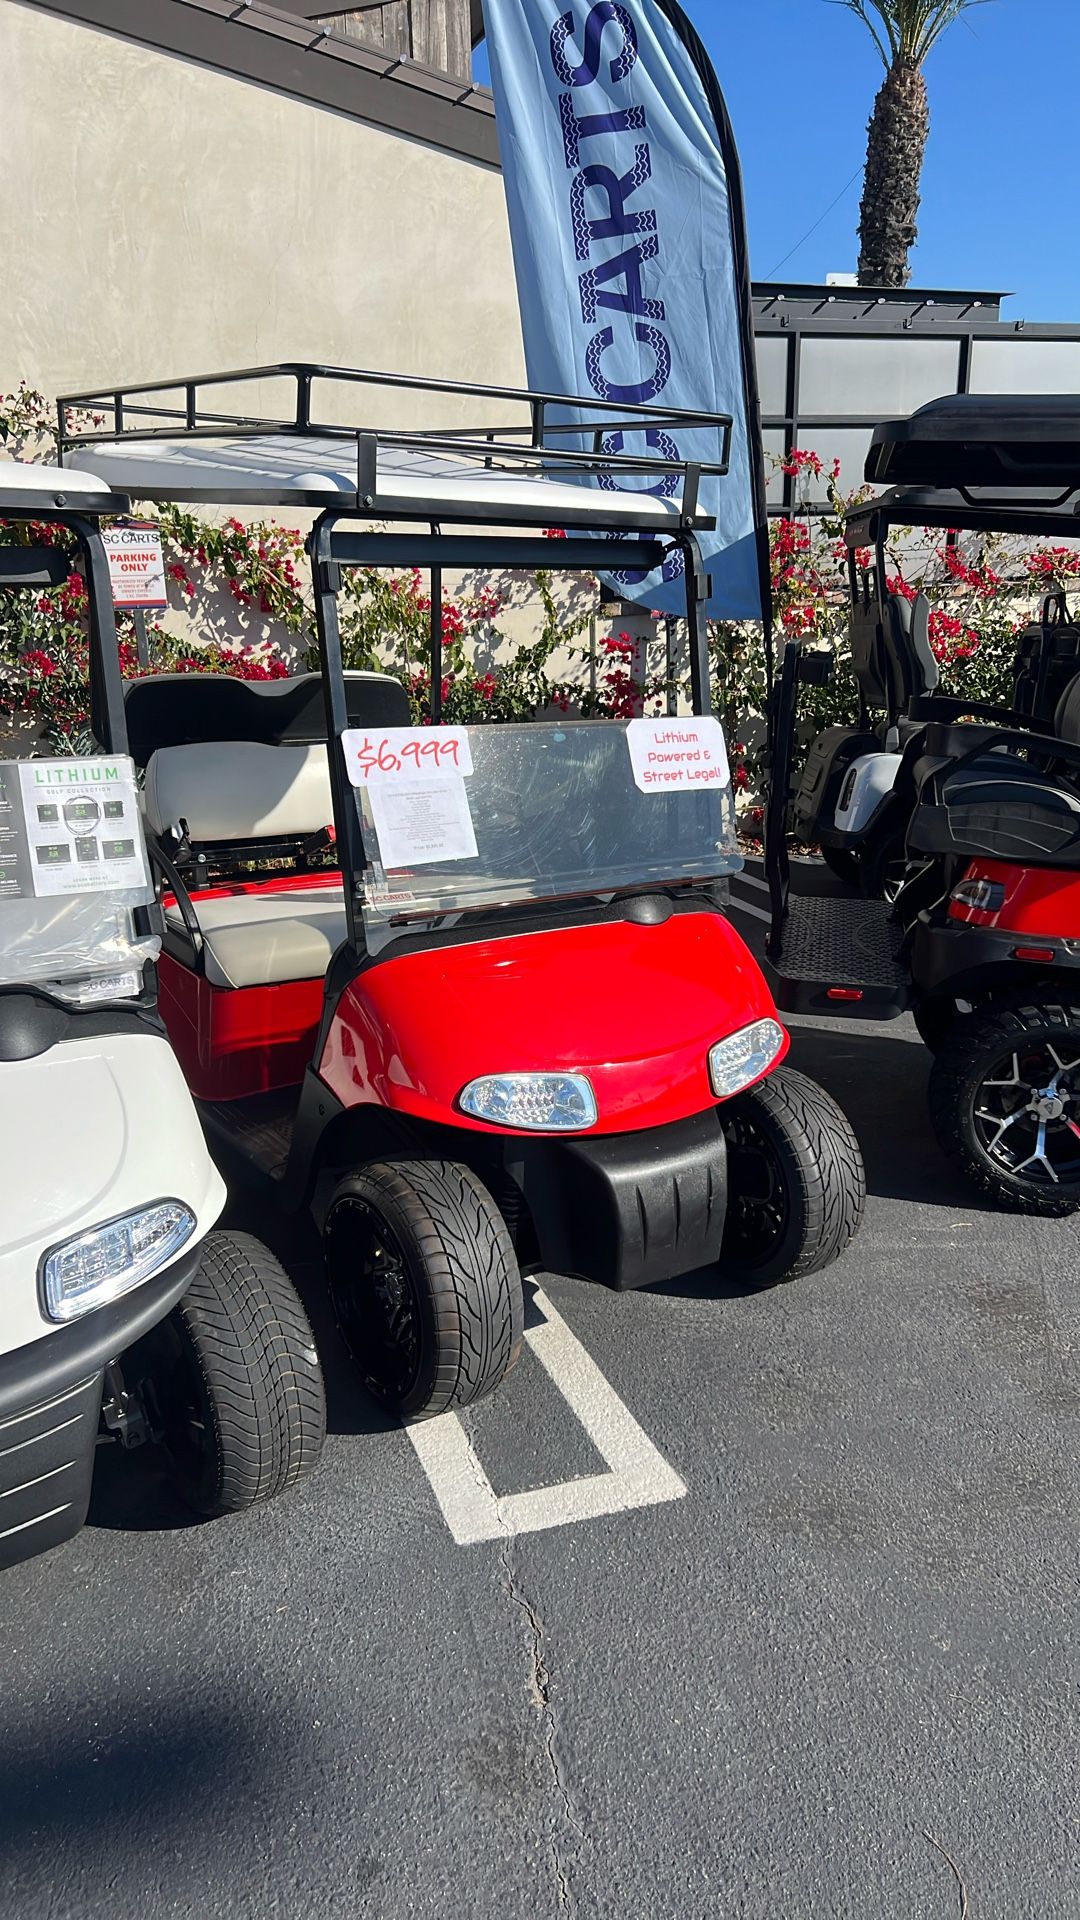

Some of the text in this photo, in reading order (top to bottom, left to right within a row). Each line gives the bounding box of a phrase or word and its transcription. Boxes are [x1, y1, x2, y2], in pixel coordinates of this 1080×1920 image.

[550, 1, 672, 404] CARTS
[103, 533, 160, 544] SC CARTS
[110, 553, 157, 562] PARKING
[121, 563, 148, 572] ONLY
[654, 732, 698, 743] Lithium
[357, 738, 459, 778] $6,999
[648, 749, 700, 762] Powered
[35, 767, 119, 783] LITHIUM
[643, 767, 721, 782] Street Legal!
[384, 893, 411, 901] CARTS
[100, 976, 134, 988] CARTS
